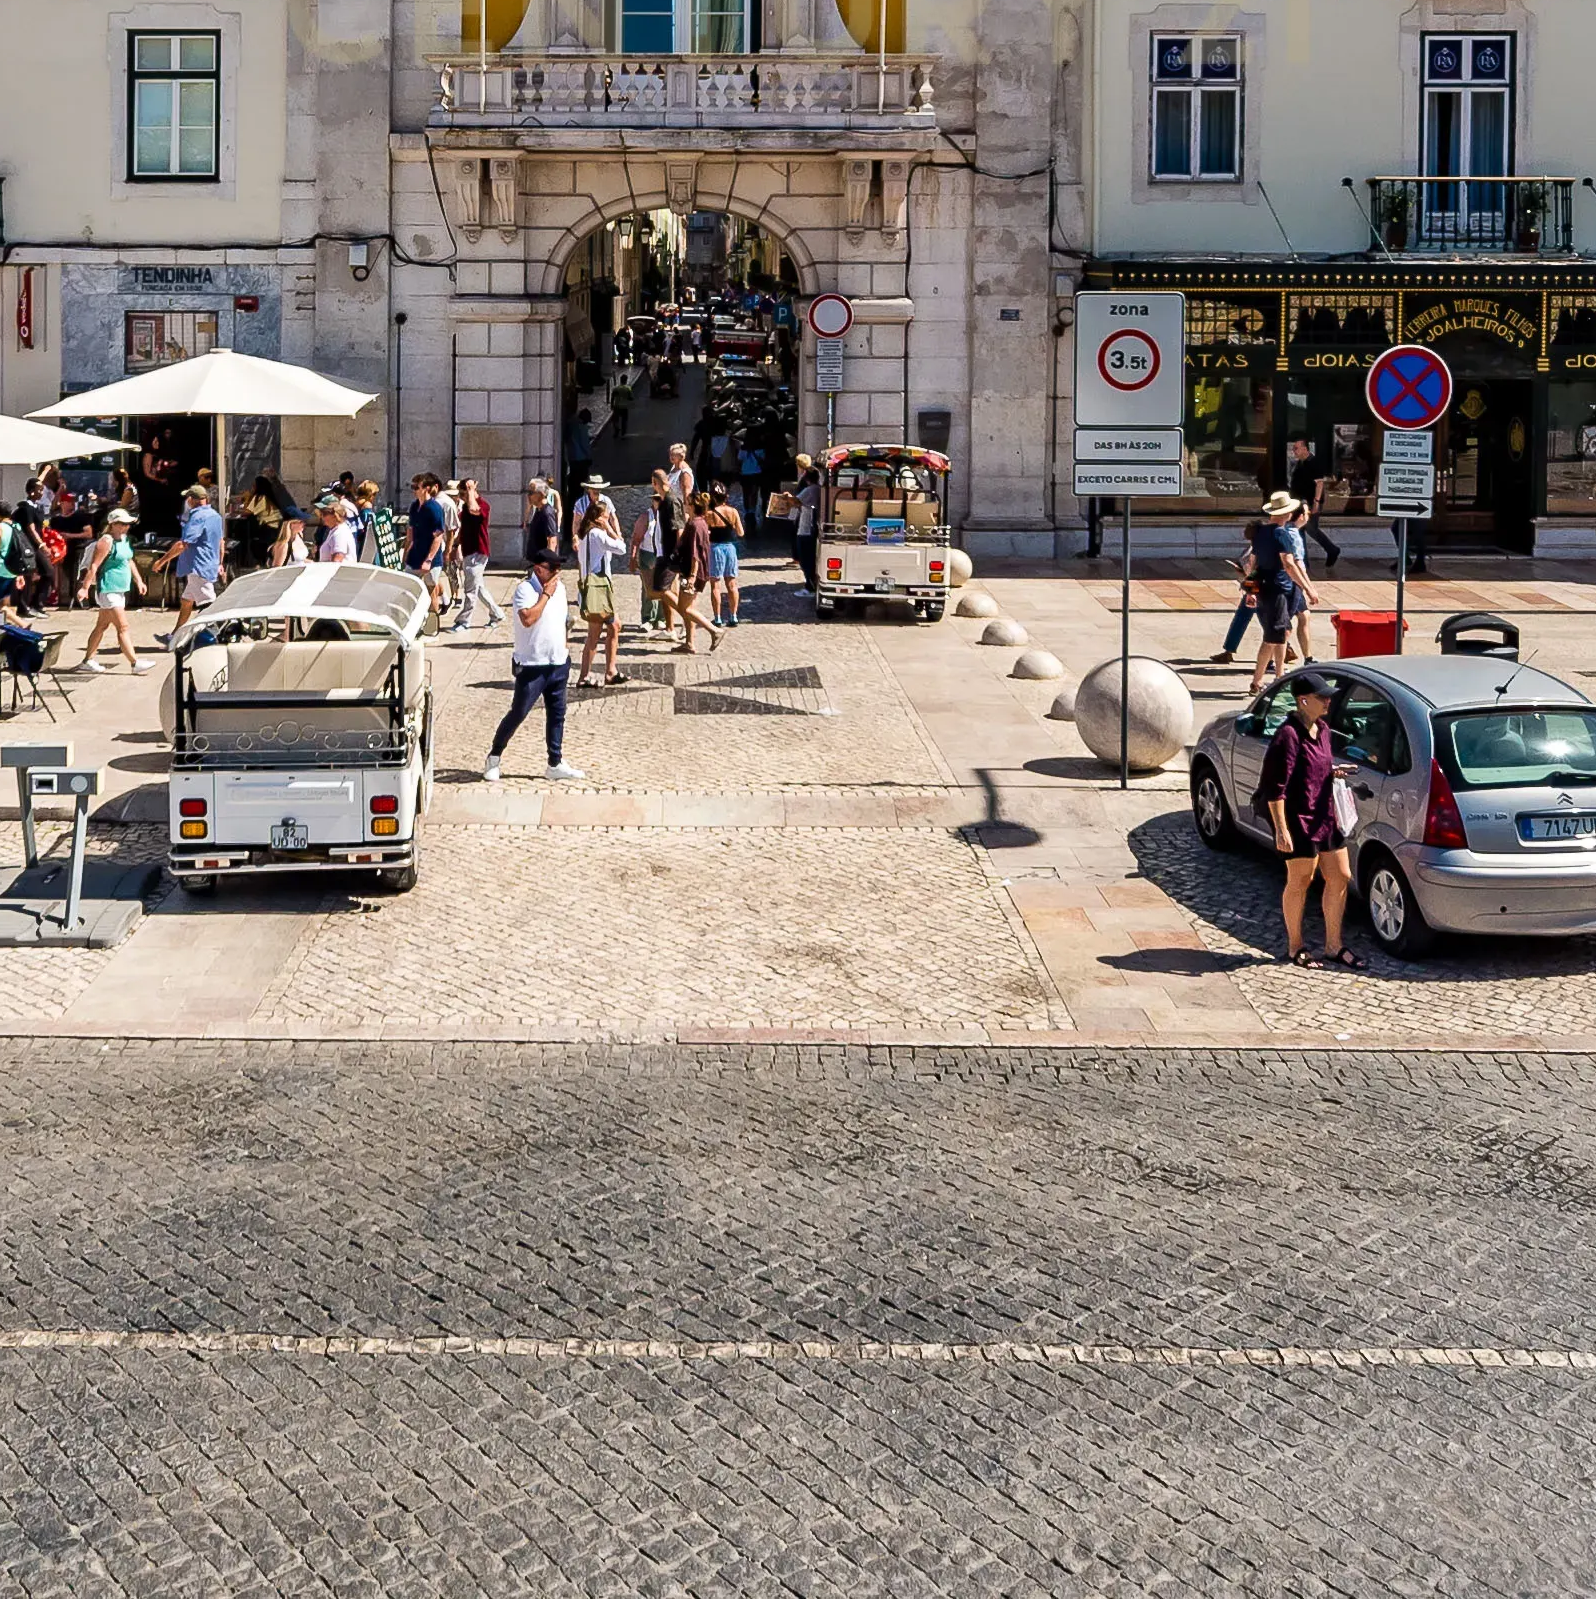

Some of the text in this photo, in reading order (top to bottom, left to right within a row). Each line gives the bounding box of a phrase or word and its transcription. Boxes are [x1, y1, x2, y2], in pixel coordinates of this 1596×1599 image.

[131, 267, 214, 284] TENDINHA
[1109, 304, 1150, 317] zona
[1426, 316, 1516, 343] JOALHEIROS
[1504, 308, 1537, 339] FILHOS
[1110, 349, 1148, 370] 3.5t
[1183, 353, 1249, 368] ATAS
[1094, 442, 1113, 450] DAS
[1143, 442, 1162, 450] 20H
[1077, 475, 1178, 484] EXCETO CARRIS E CML
